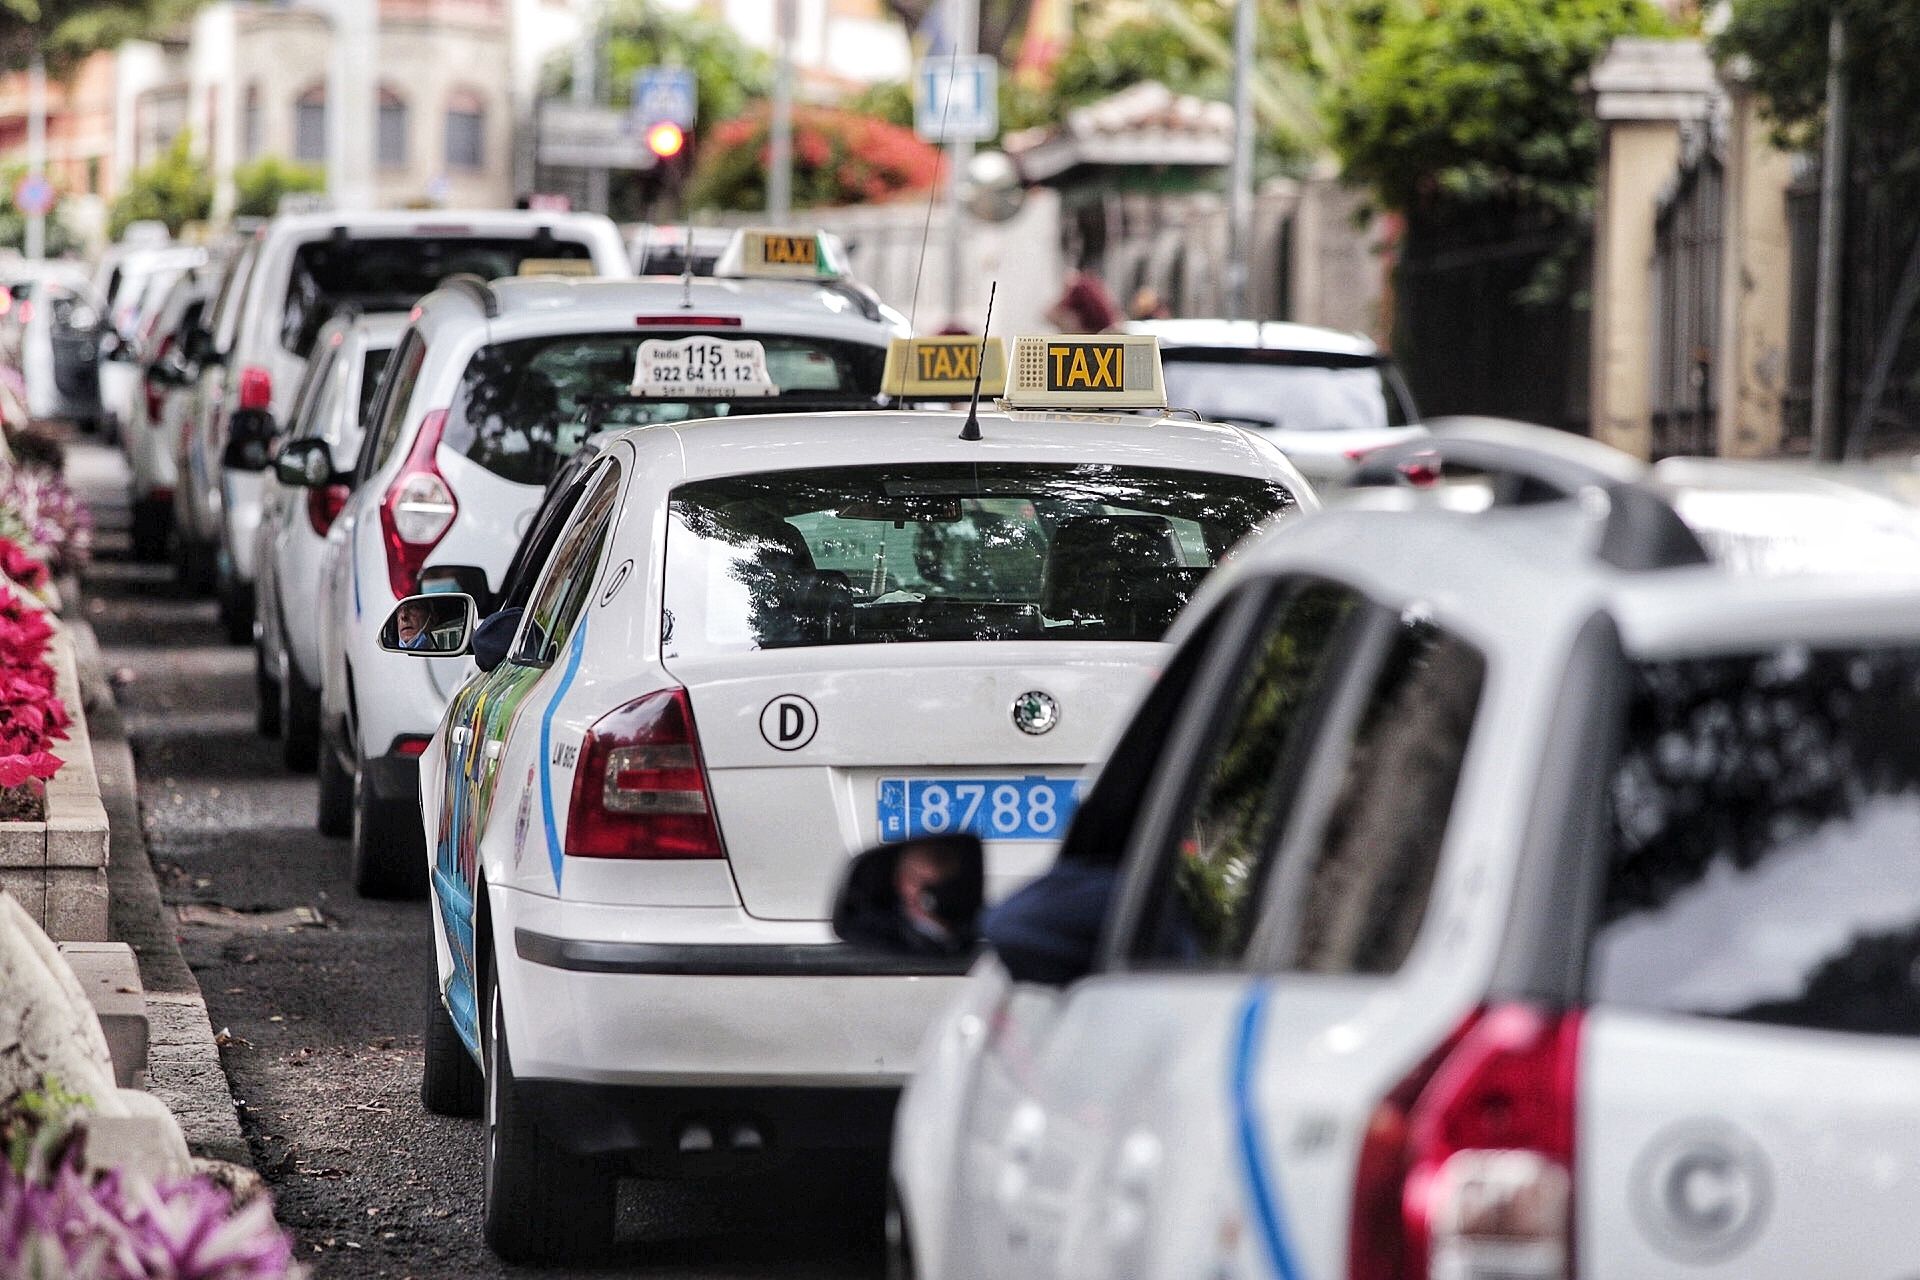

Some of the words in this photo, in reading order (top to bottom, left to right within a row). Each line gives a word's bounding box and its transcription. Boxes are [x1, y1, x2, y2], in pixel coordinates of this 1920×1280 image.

[765, 234, 816, 263] TAXI
[684, 345, 723, 366] 115
[919, 346, 978, 379] TAXI
[1049, 347, 1123, 387] TAXI
[653, 367, 680, 381] 922
[686, 366, 704, 381] 64
[711, 366, 727, 381] 11
[734, 366, 752, 381] 12
[779, 702, 804, 742] D
[888, 815, 900, 831] E
[920, 784, 1057, 834] 8788
